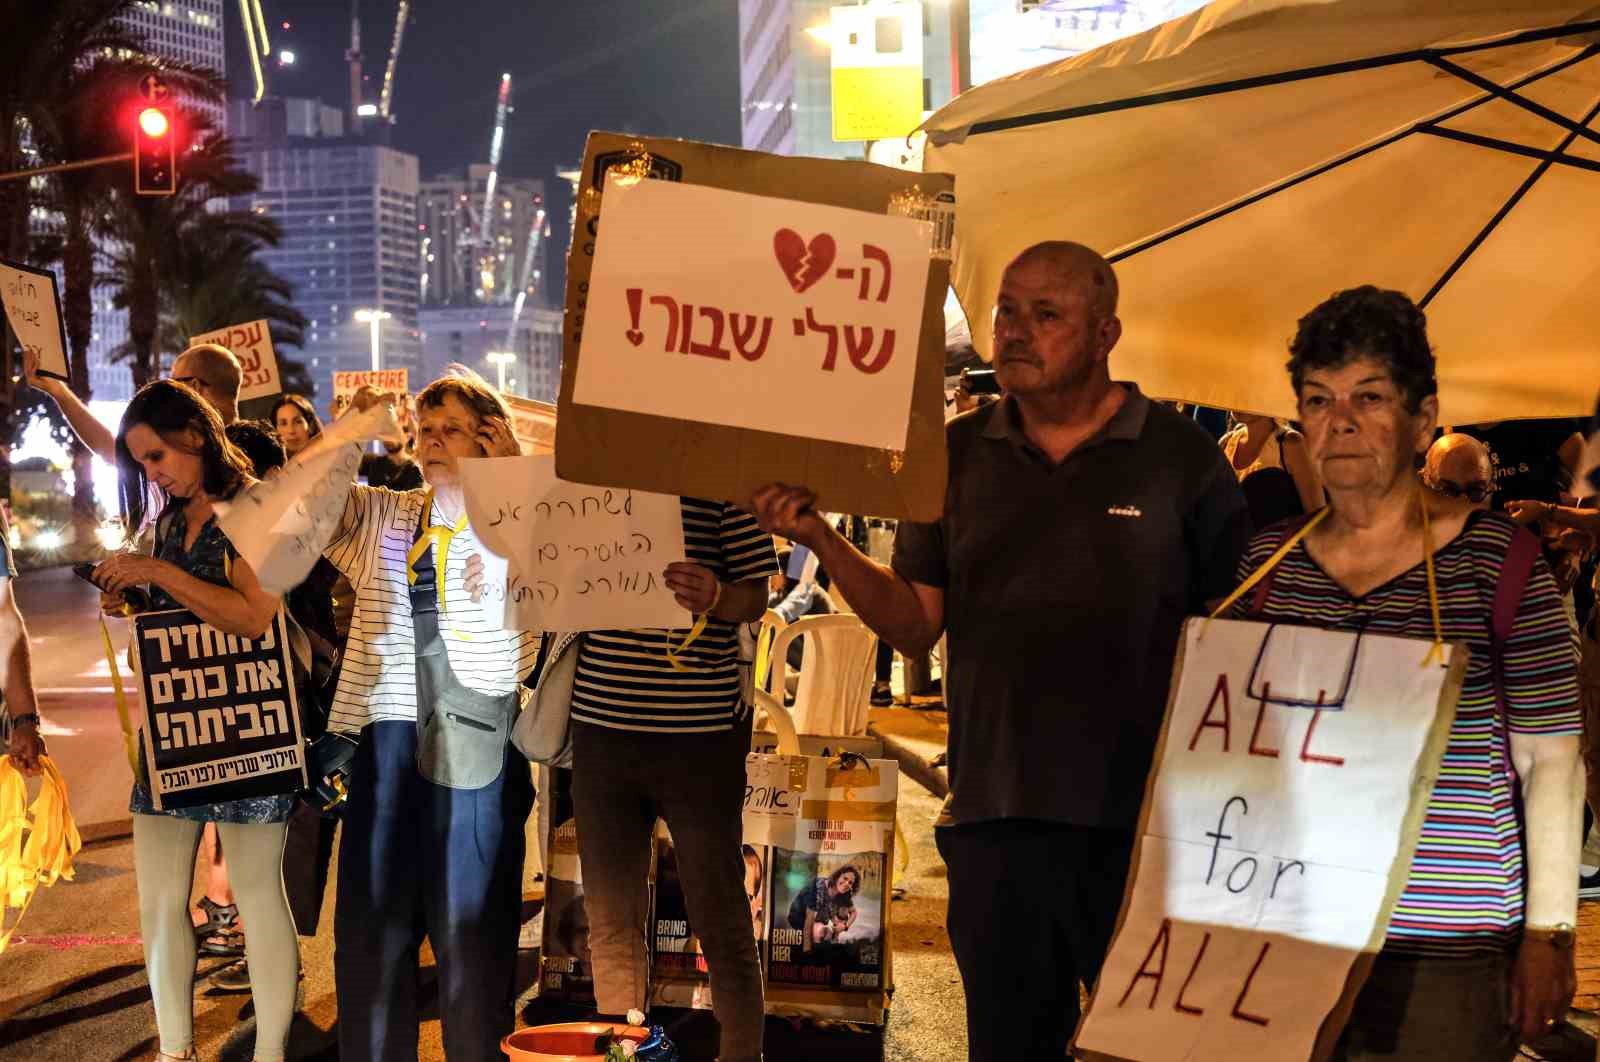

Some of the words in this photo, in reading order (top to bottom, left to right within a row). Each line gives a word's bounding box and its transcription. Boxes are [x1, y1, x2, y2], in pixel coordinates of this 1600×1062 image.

[625, 288, 773, 362] שבור!
[792, 307, 896, 375] שלי
[336, 371, 405, 389] CEASEFIRE
[150, 666, 229, 704] כולם
[235, 659, 283, 694] את
[156, 700, 289, 750] הביתה!
[1188, 674, 1345, 767] ALL
[217, 756, 259, 779] שבויים
[261, 750, 298, 770] חילופי
[160, 770, 190, 790] הכל!
[191, 764, 216, 783] לפני
[1206, 796, 1305, 899] for
[657, 919, 688, 936] BRING
[772, 928, 803, 945] BRING
[656, 937, 677, 953] HIM
[771, 946, 791, 962] HER
[1117, 917, 1272, 1028] ALL
